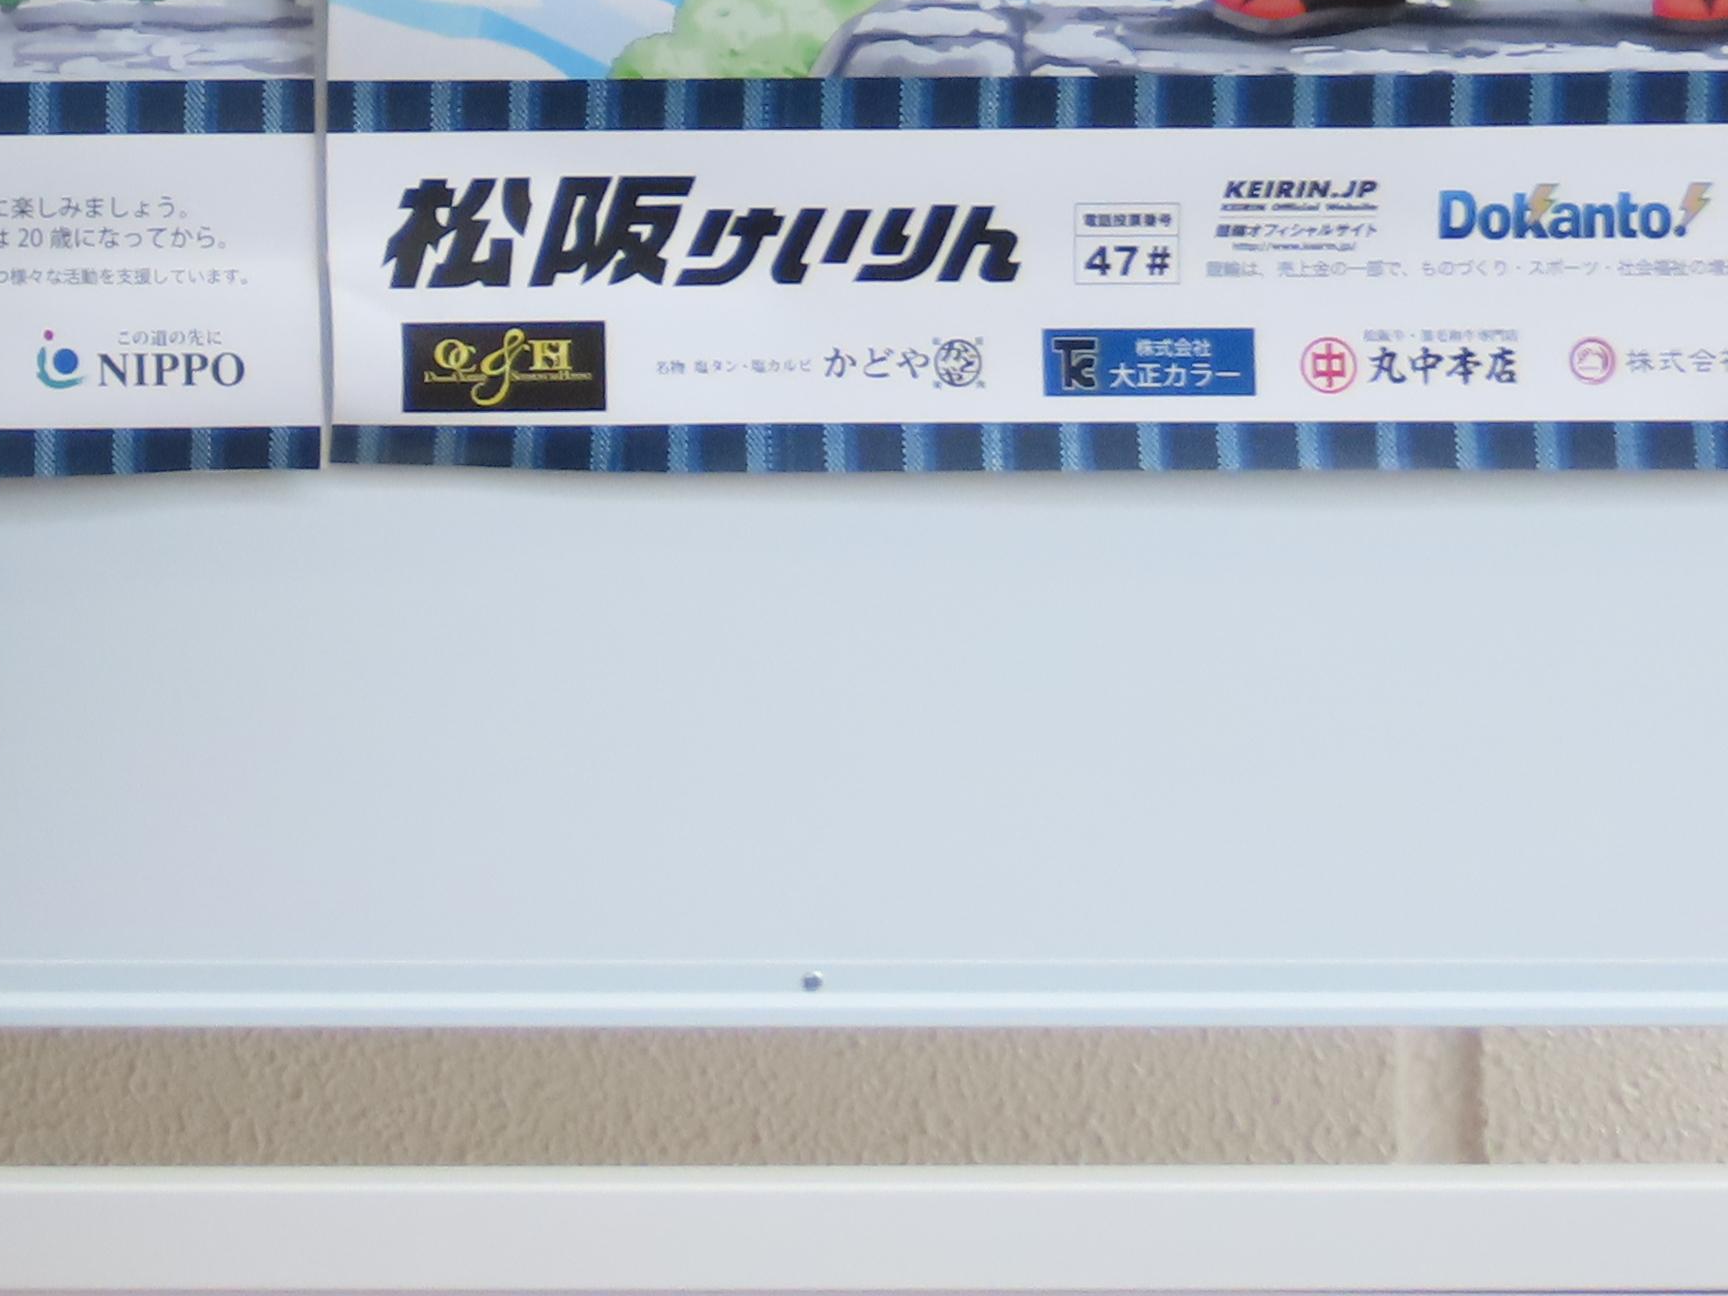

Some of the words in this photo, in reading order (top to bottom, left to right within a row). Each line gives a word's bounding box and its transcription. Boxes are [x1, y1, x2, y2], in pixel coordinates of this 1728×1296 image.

[1223, 179, 1378, 199] KEIRIN.JP
[381, 175, 1022, 289] 松阪けいりん
[823, 346, 931, 379] かどや
[1135, 338, 1212, 357] 株式会社
[97, 351, 246, 388] NIPPO
[1108, 361, 1242, 389] 大正カラー
[1367, 345, 1518, 386] 丸中本店
